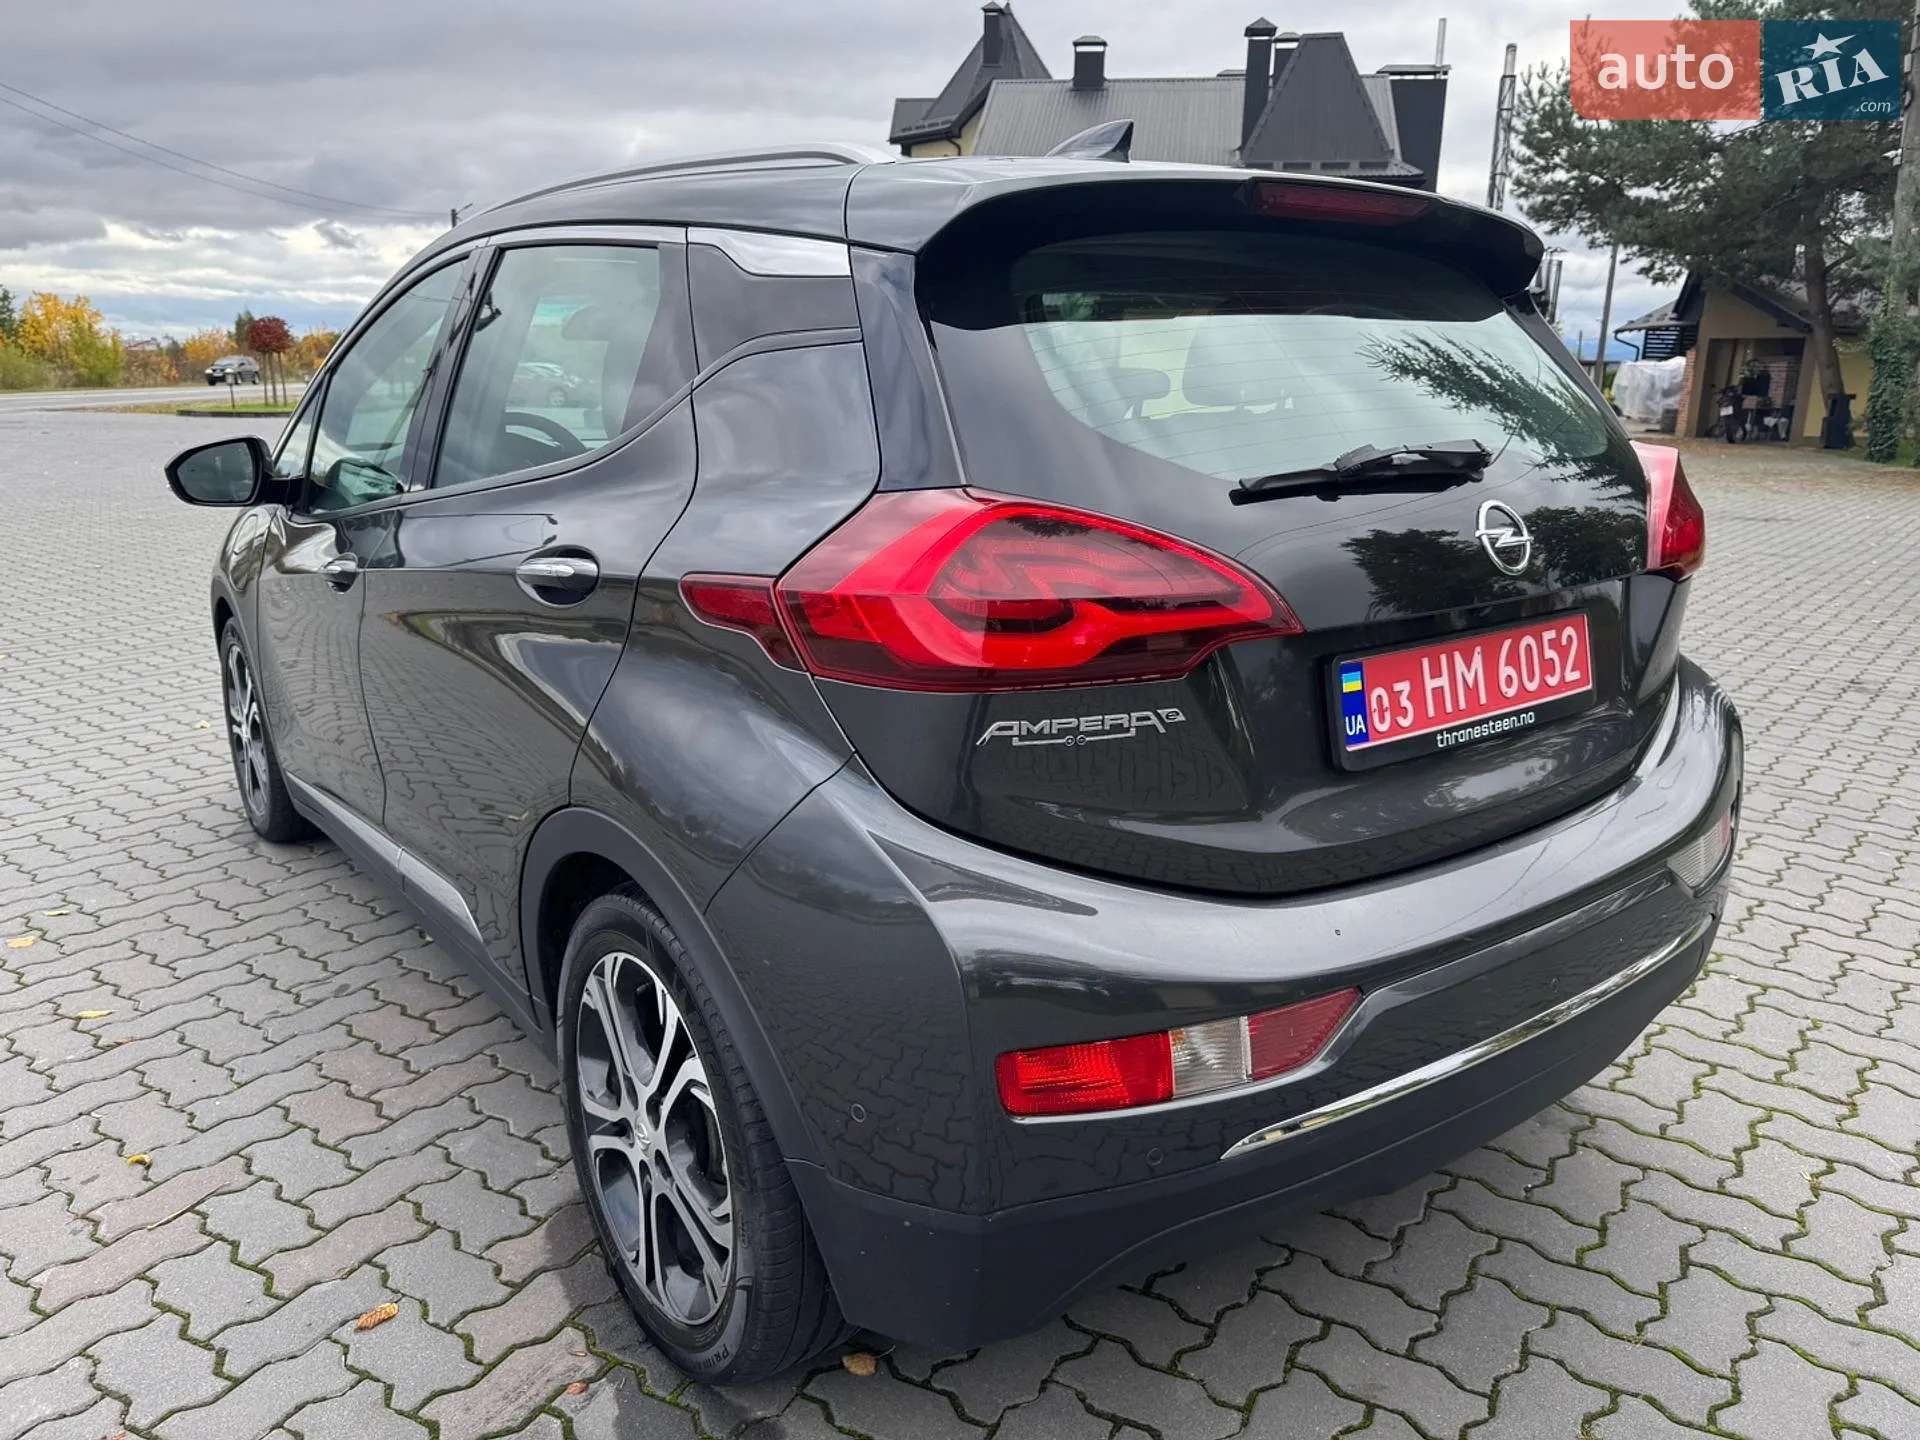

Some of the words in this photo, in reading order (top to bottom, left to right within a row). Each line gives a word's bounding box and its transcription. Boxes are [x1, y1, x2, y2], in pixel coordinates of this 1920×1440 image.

[1370, 679, 1415, 733] 03
[1421, 645, 1487, 718] HM
[1498, 625, 1582, 699] 6052
[1345, 713, 1366, 736] UA
[1436, 711, 1535, 748] thranesteen.no
